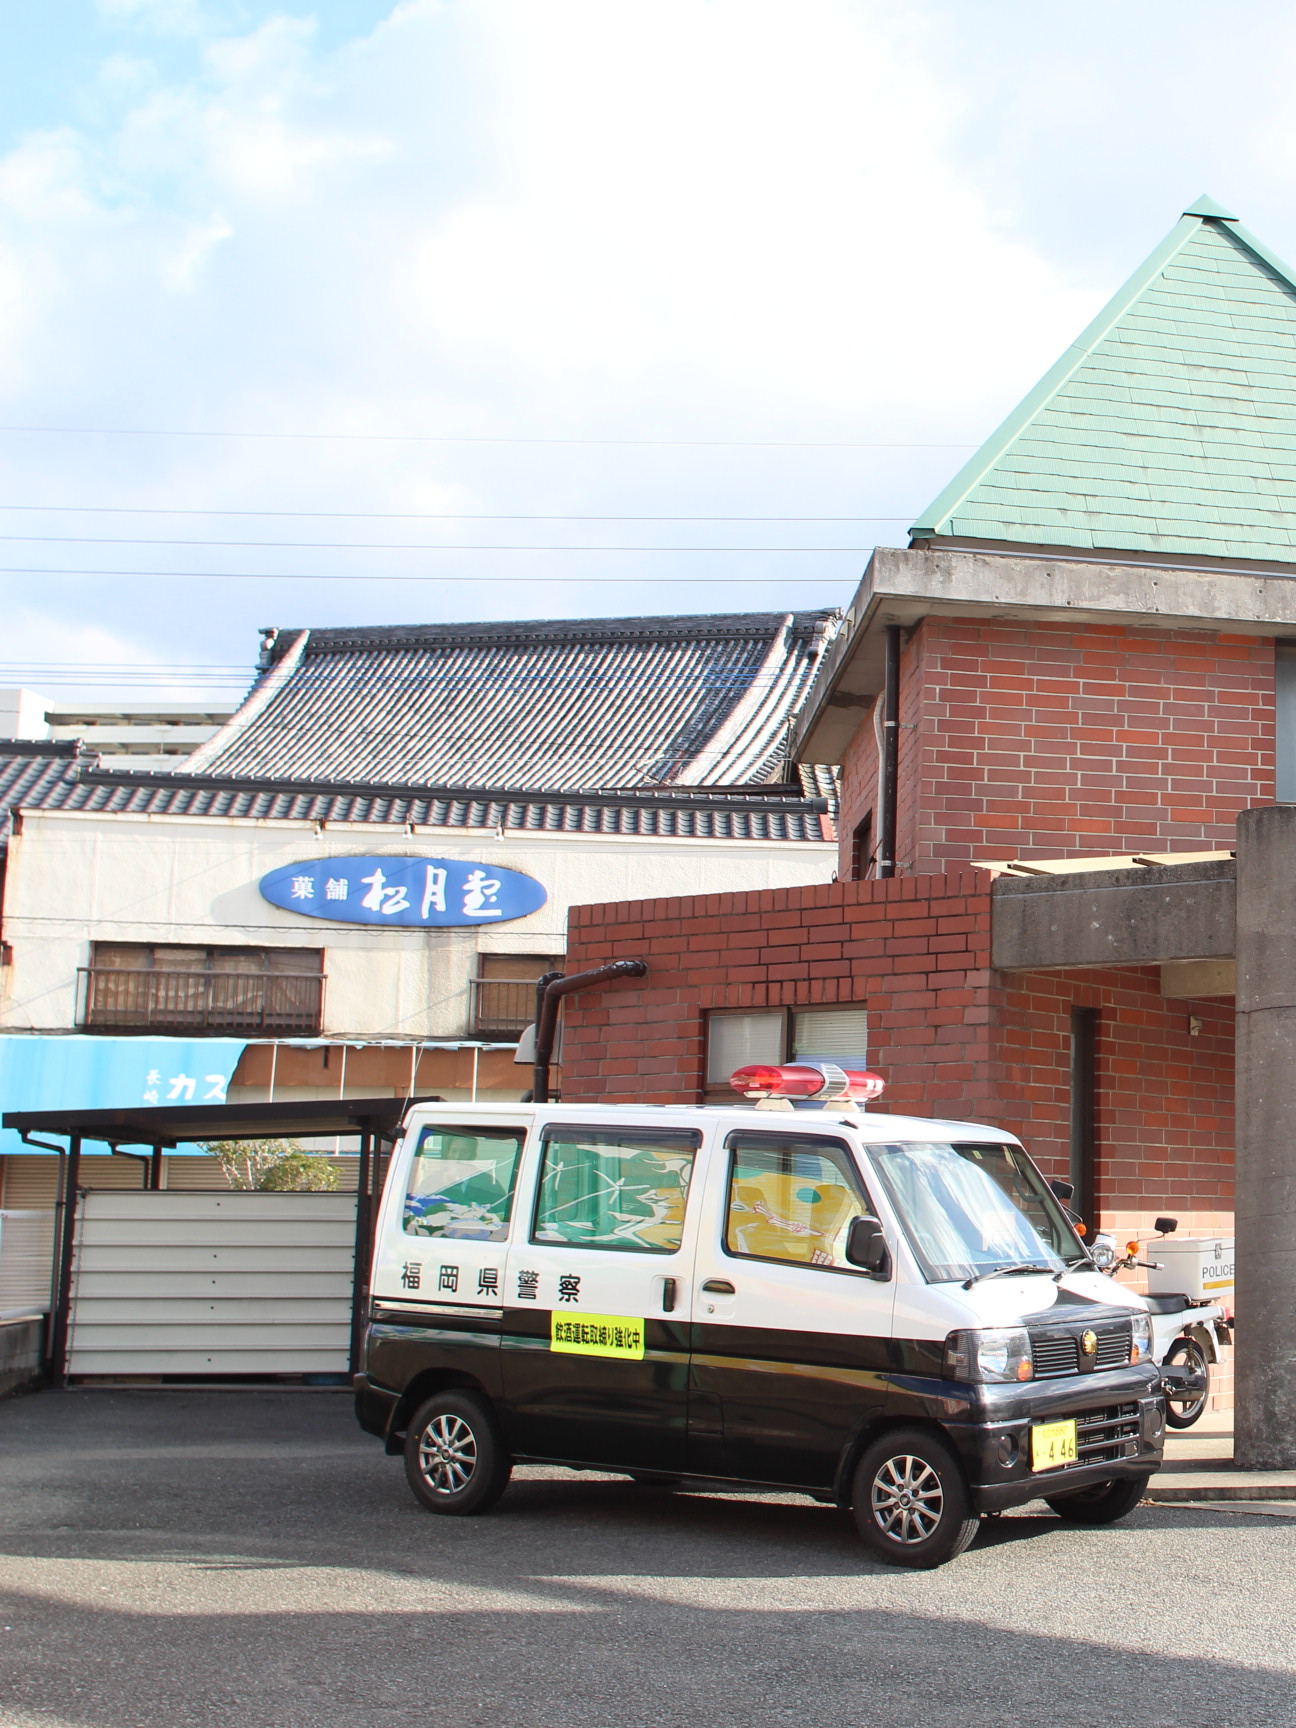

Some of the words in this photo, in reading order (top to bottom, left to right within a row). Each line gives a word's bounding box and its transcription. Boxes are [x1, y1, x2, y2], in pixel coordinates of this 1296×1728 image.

[401, 1261, 581, 1303] 福岡県警察
[1202, 1263, 1236, 1279] POLICE
